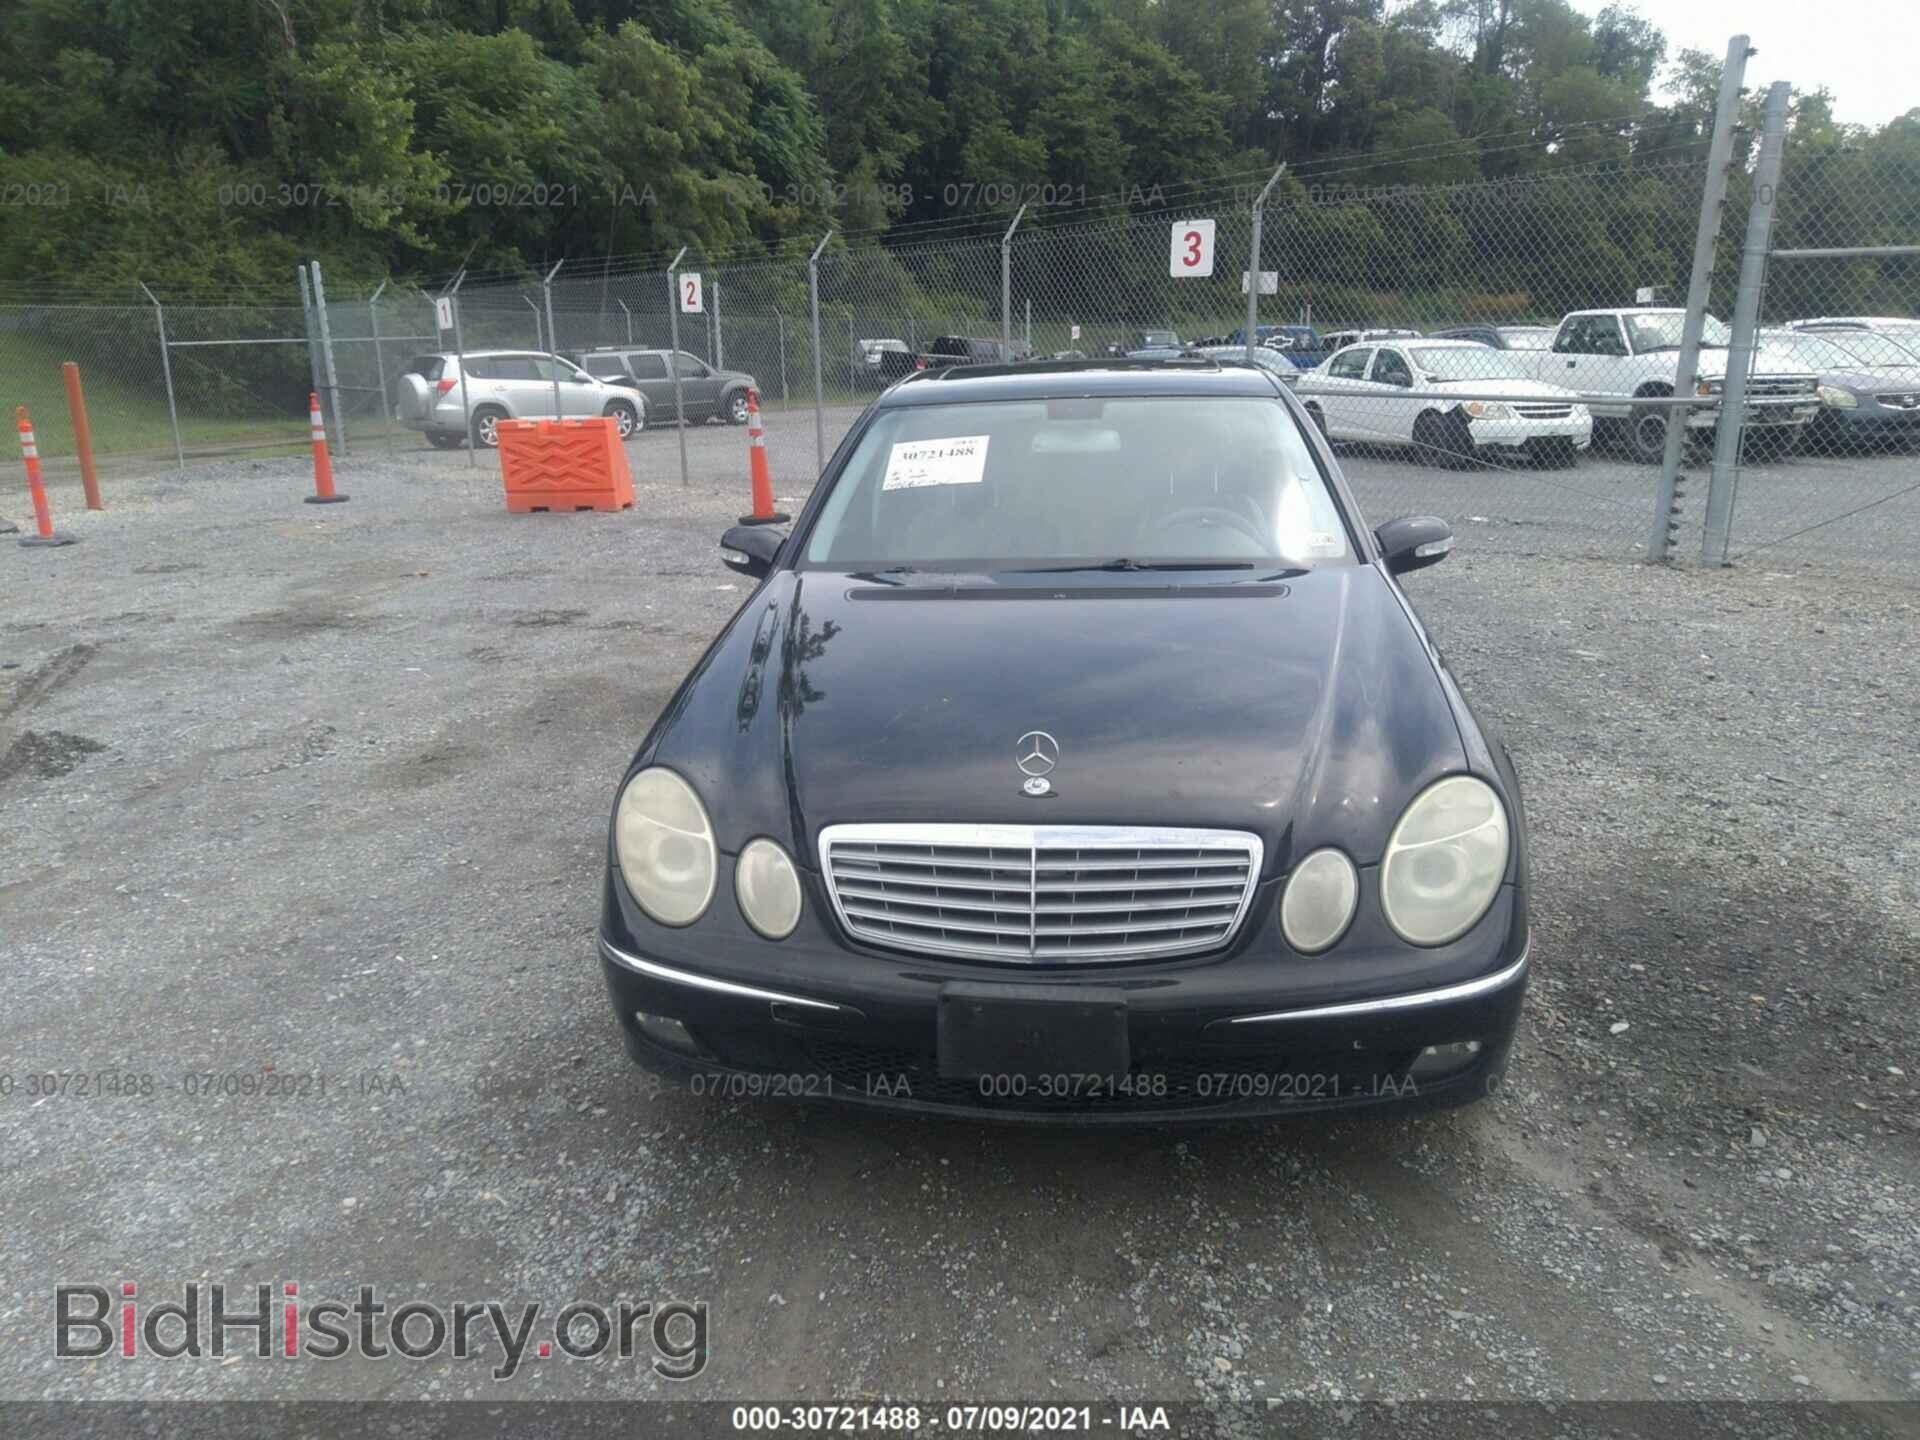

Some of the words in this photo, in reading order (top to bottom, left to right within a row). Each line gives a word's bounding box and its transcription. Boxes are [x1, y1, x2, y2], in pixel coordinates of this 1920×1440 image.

[1183, 231, 1202, 267] 3
[687, 281, 696, 305] 2
[441, 303, 449, 323] 1
